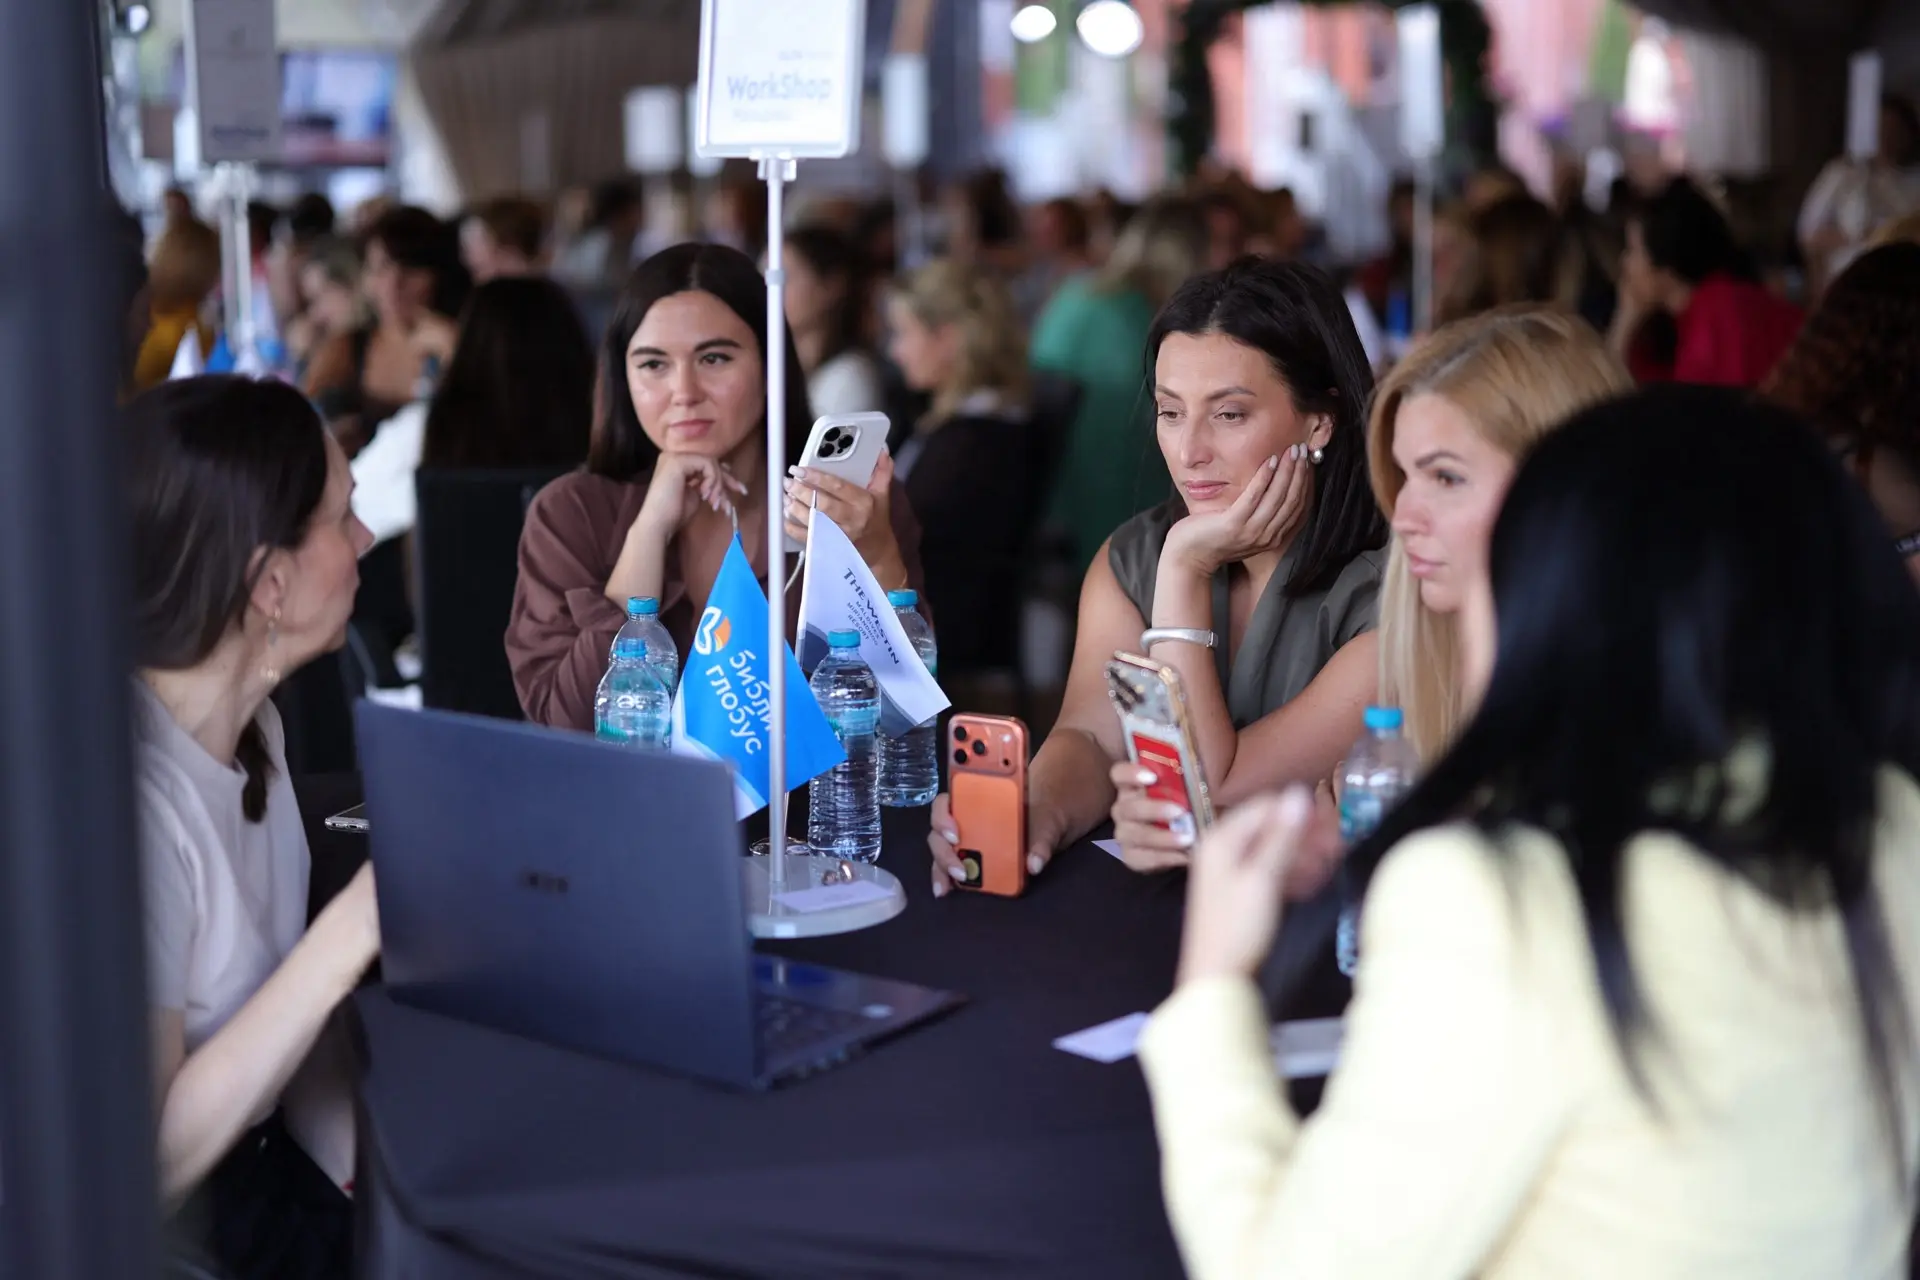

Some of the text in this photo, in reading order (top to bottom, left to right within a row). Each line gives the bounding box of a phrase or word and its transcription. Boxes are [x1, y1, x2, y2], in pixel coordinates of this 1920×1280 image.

[727, 72, 832, 102] WorkShop
[843, 567, 900, 665] THE WESTIN
[847, 614, 870, 640] RESORT
[855, 600, 880, 640] MALDIVES
[705, 664, 762, 755] глобус
[729, 649, 772, 732] библи
